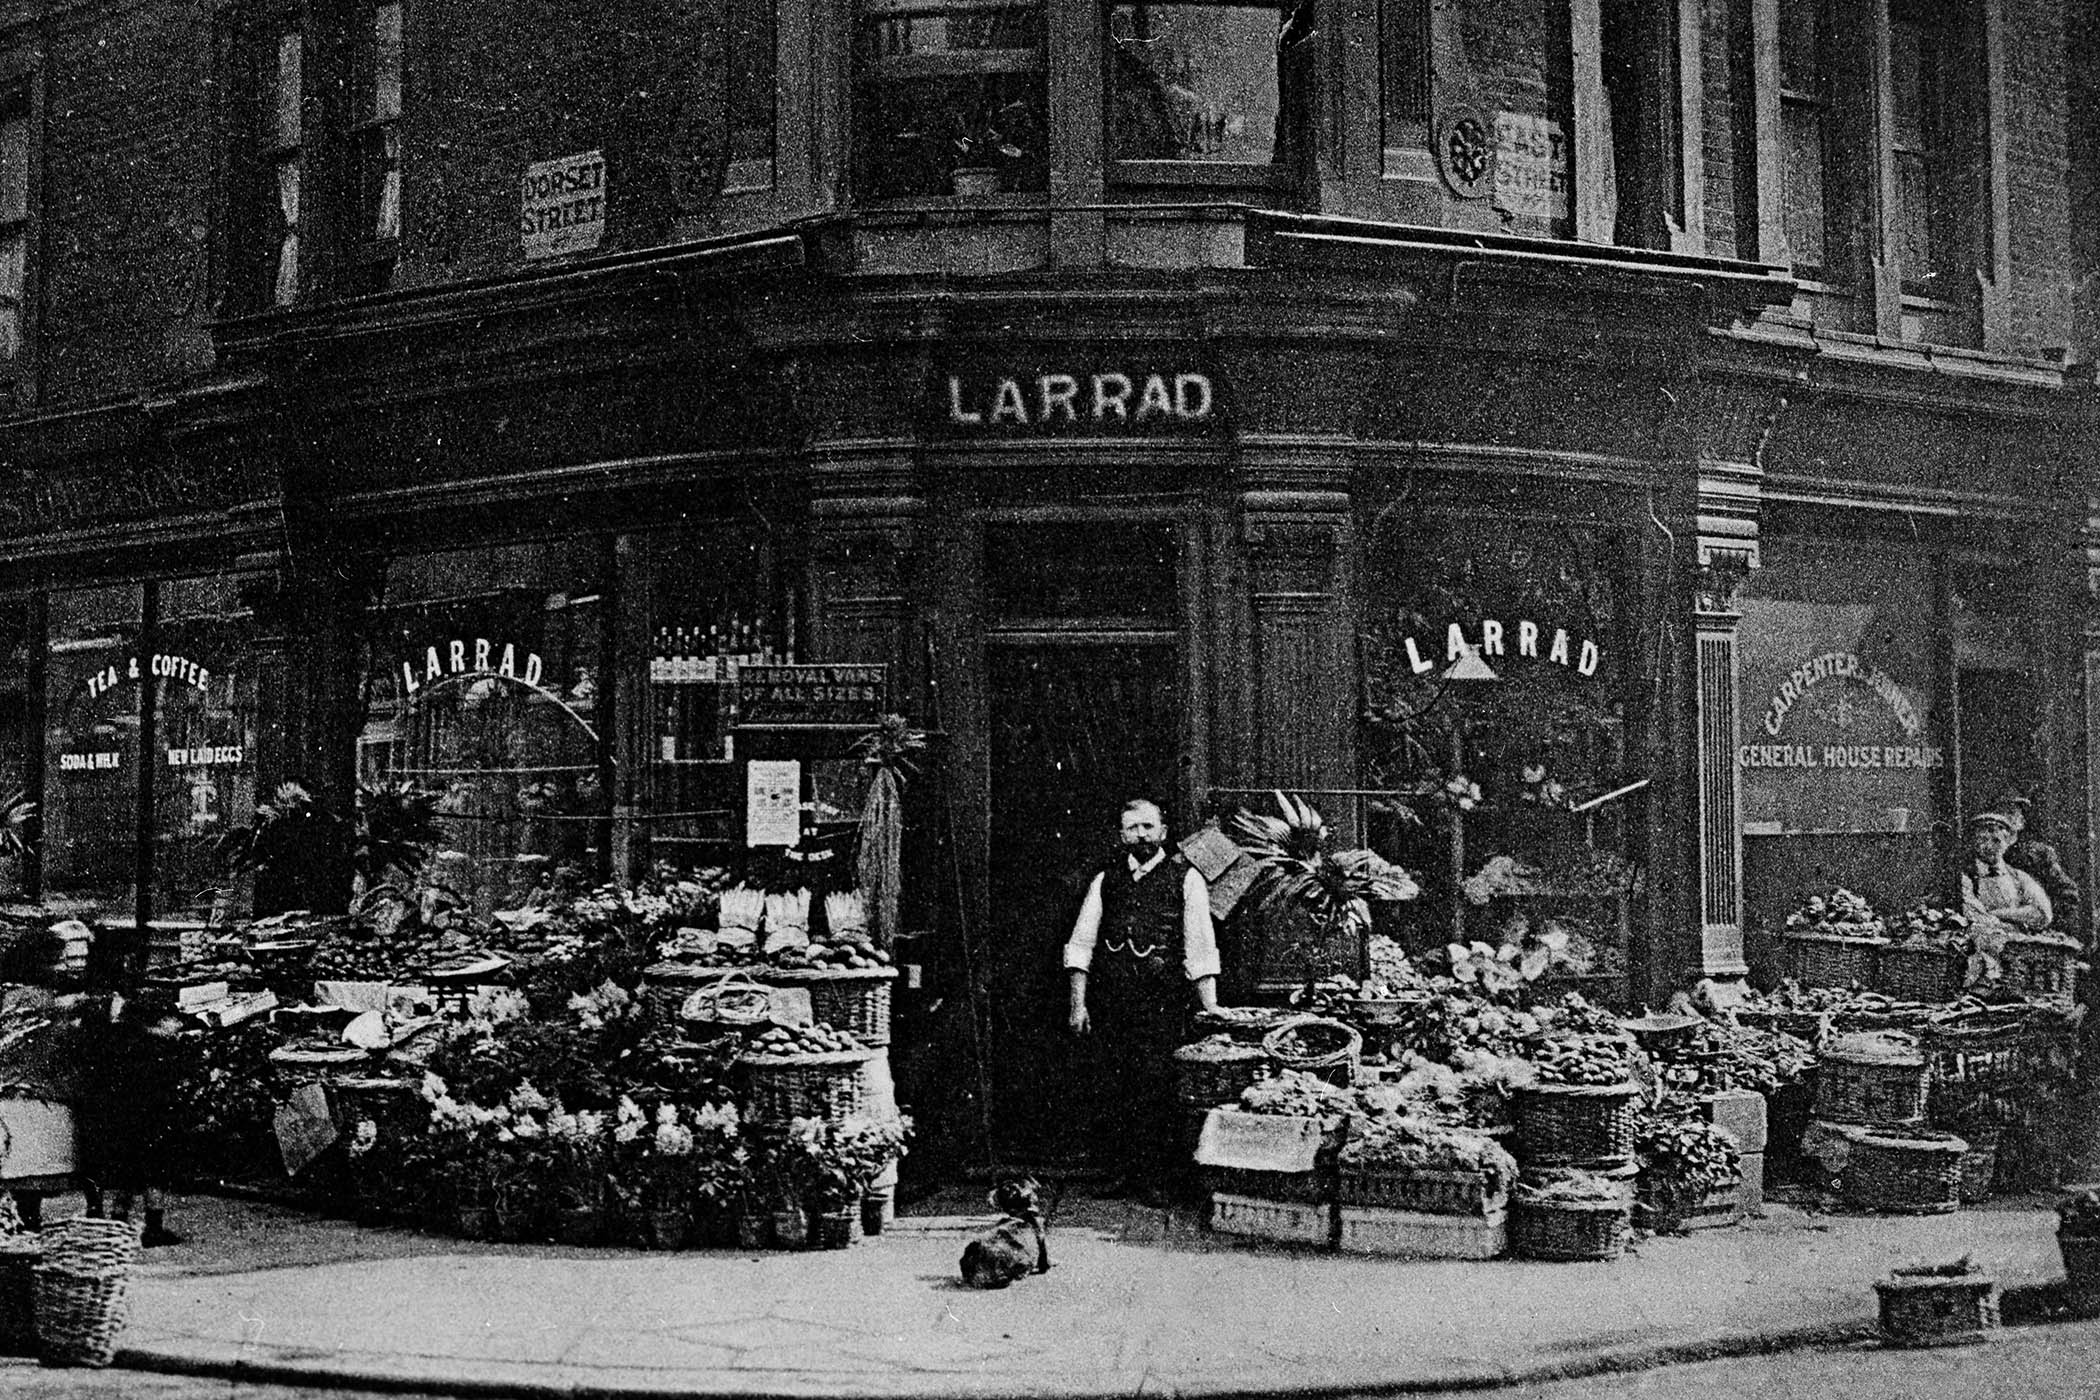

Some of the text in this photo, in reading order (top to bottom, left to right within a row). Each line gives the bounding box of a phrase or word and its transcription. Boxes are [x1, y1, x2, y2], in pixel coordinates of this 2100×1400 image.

[524, 161, 603, 202] DORSET
[521, 195, 602, 235] STREET
[949, 374, 1212, 424] LARRAD
[403, 638, 542, 693] LARRAD
[1405, 620, 1599, 677] LARRAD
[87, 654, 209, 698] TEA & COFFEE
[742, 686, 766, 702] OF
[771, 686, 805, 702] ALL
[743, 668, 883, 684] REMOVAL VANS
[1765, 651, 1857, 736] CARPENTER
[60, 752, 120, 770] SODA & MILK
[167, 745, 243, 765] NEW LAID EGGS
[1739, 745, 1944, 768] GENERAL HOUSE REPAIRS
